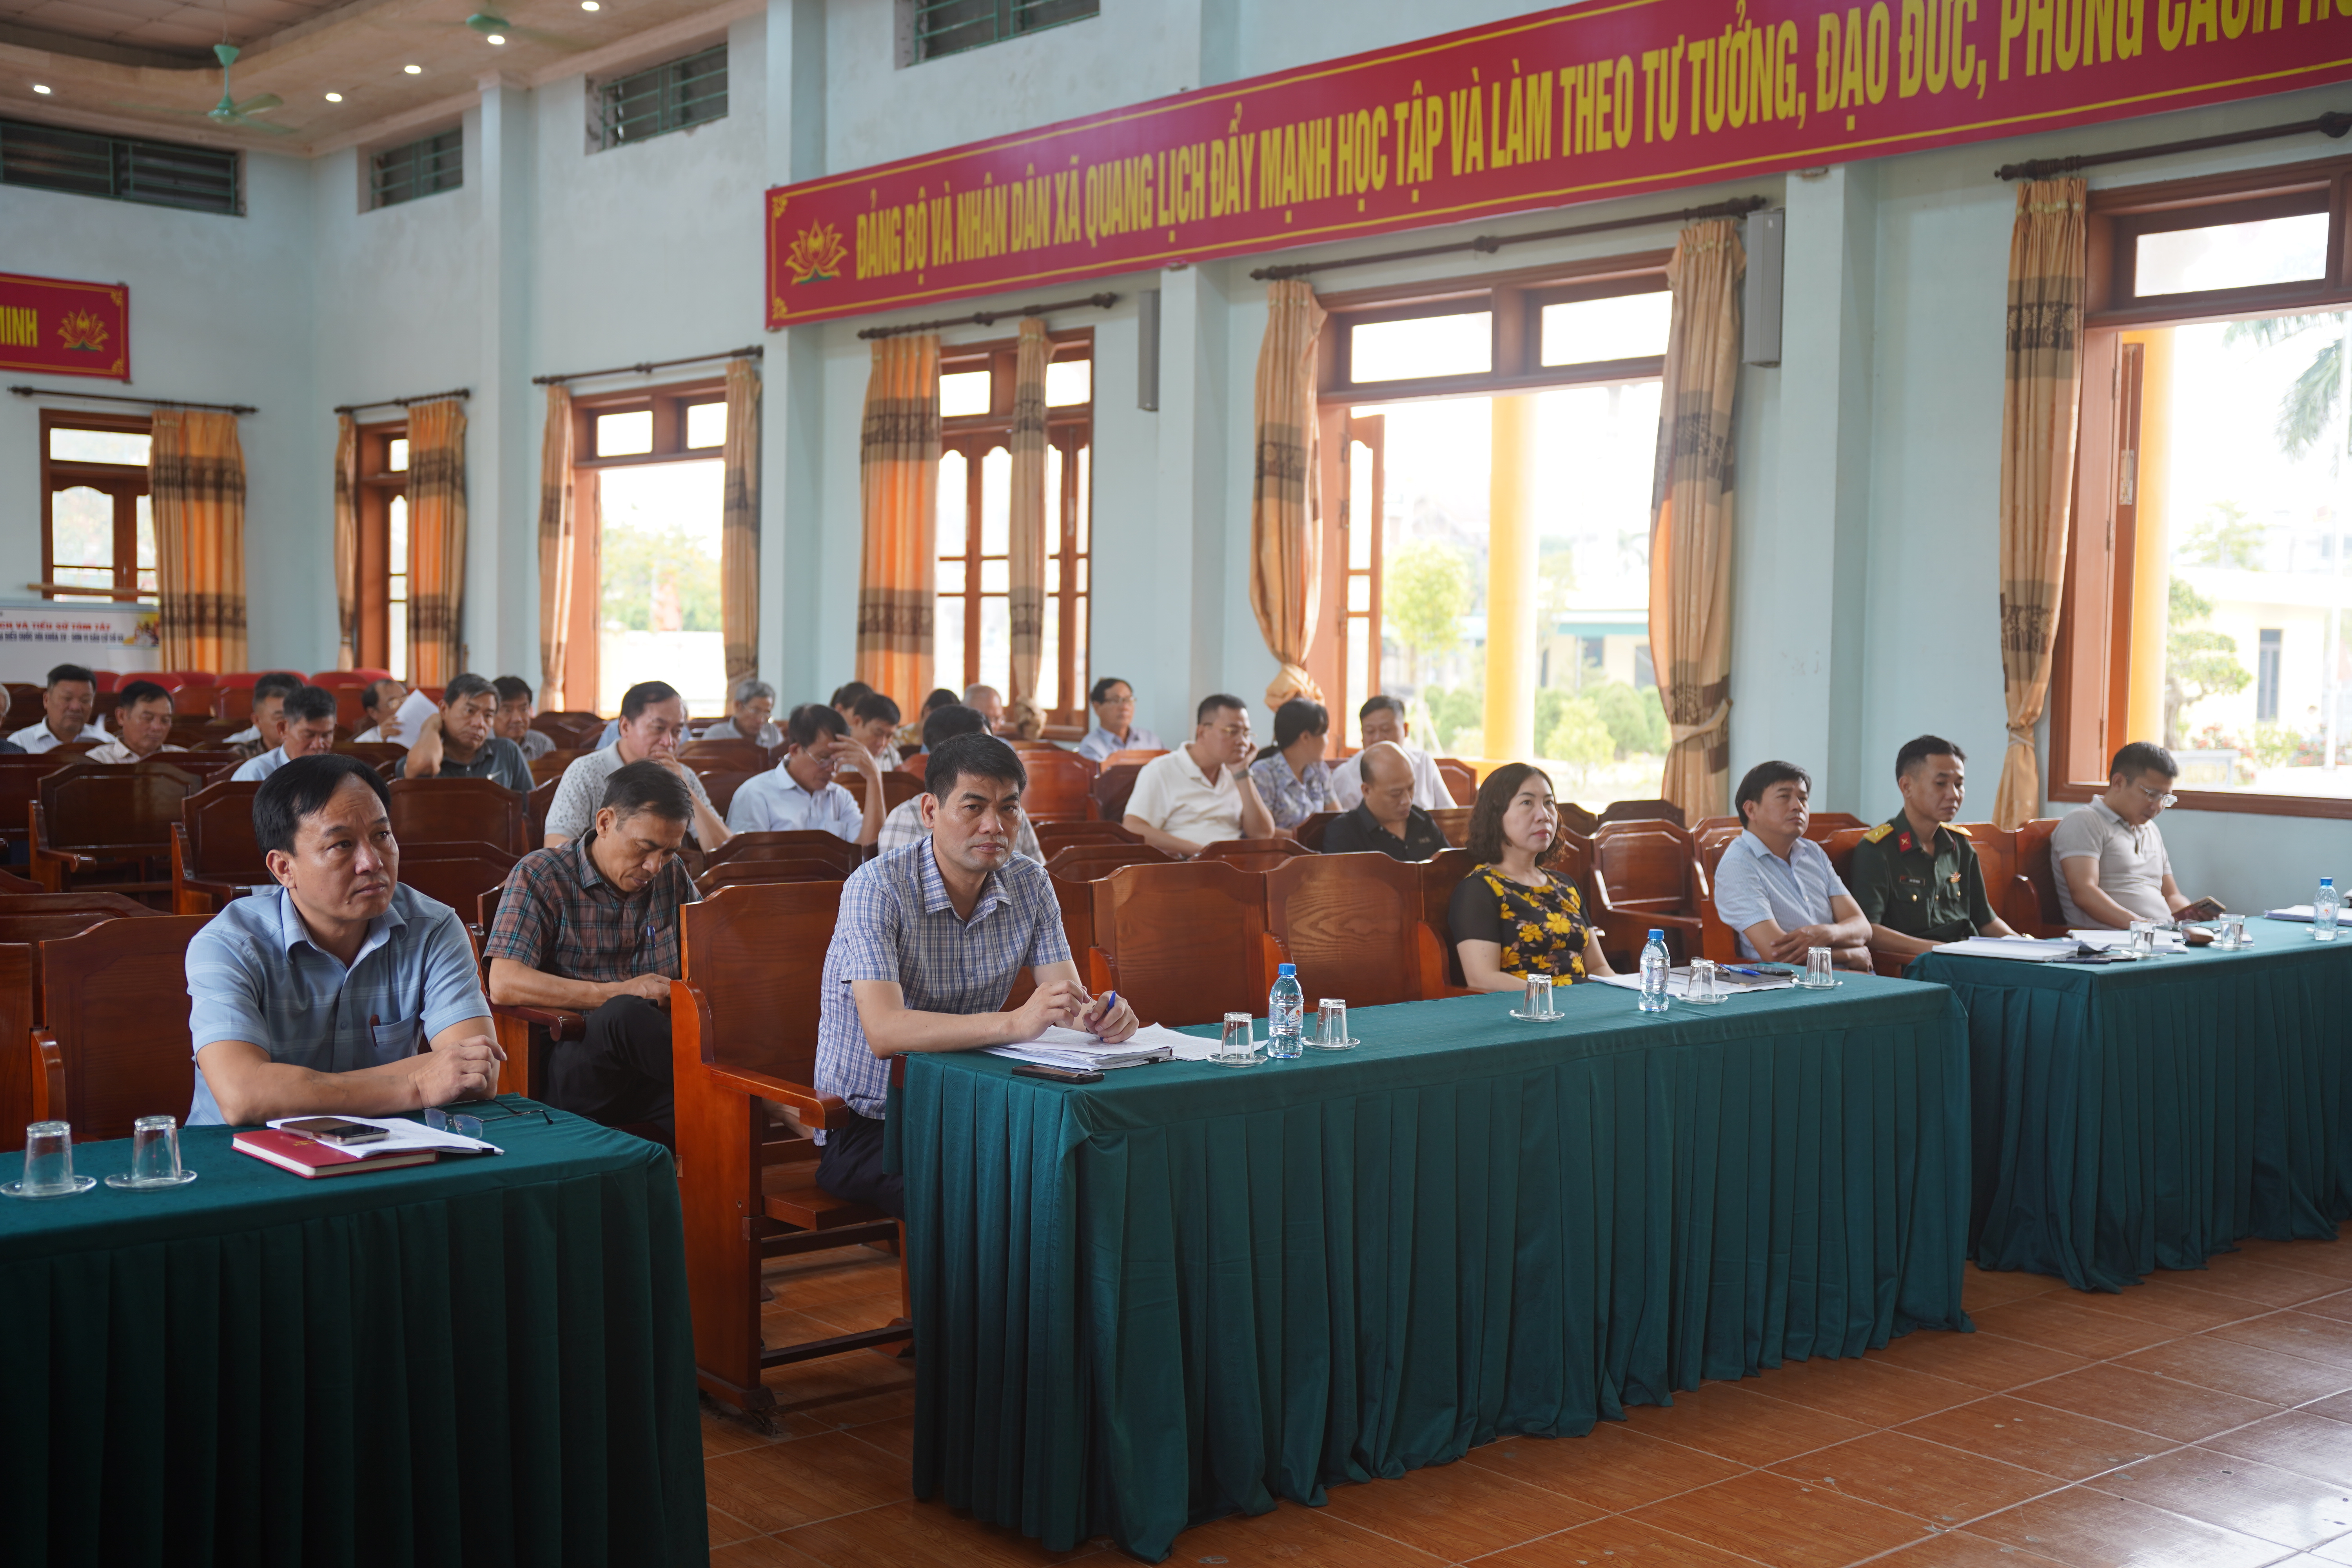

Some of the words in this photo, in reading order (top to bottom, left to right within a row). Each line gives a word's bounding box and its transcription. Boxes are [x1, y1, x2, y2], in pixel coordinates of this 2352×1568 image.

[856, 188, 901, 280] ĐẢNG
[904, 186, 928, 285] BỘ
[931, 181, 953, 267] VÀ
[956, 172, 1008, 262] NHÂN
[1010, 163, 1050, 253] DÂN
[1053, 154, 1081, 244] XÃ
[1085, 153, 1153, 248] QUANG
[1157, 142, 1206, 243] LỊCH
[1210, 102, 1255, 218] ĐẨY
[1259, 117, 1332, 223] MẠNH
[1337, 105, 1388, 212] HỌC
[1394, 80, 1443, 203] TẬP
[1450, 67, 1484, 176] VÀ
[1491, 58, 1553, 169] LÀM
[1559, 54, 1634, 157] THEO
[1642, 34, 1684, 143] TƯ
[1688, 0, 1806, 136] TƯỞNG,
[1816, 1, 1890, 131] ĐẠO
